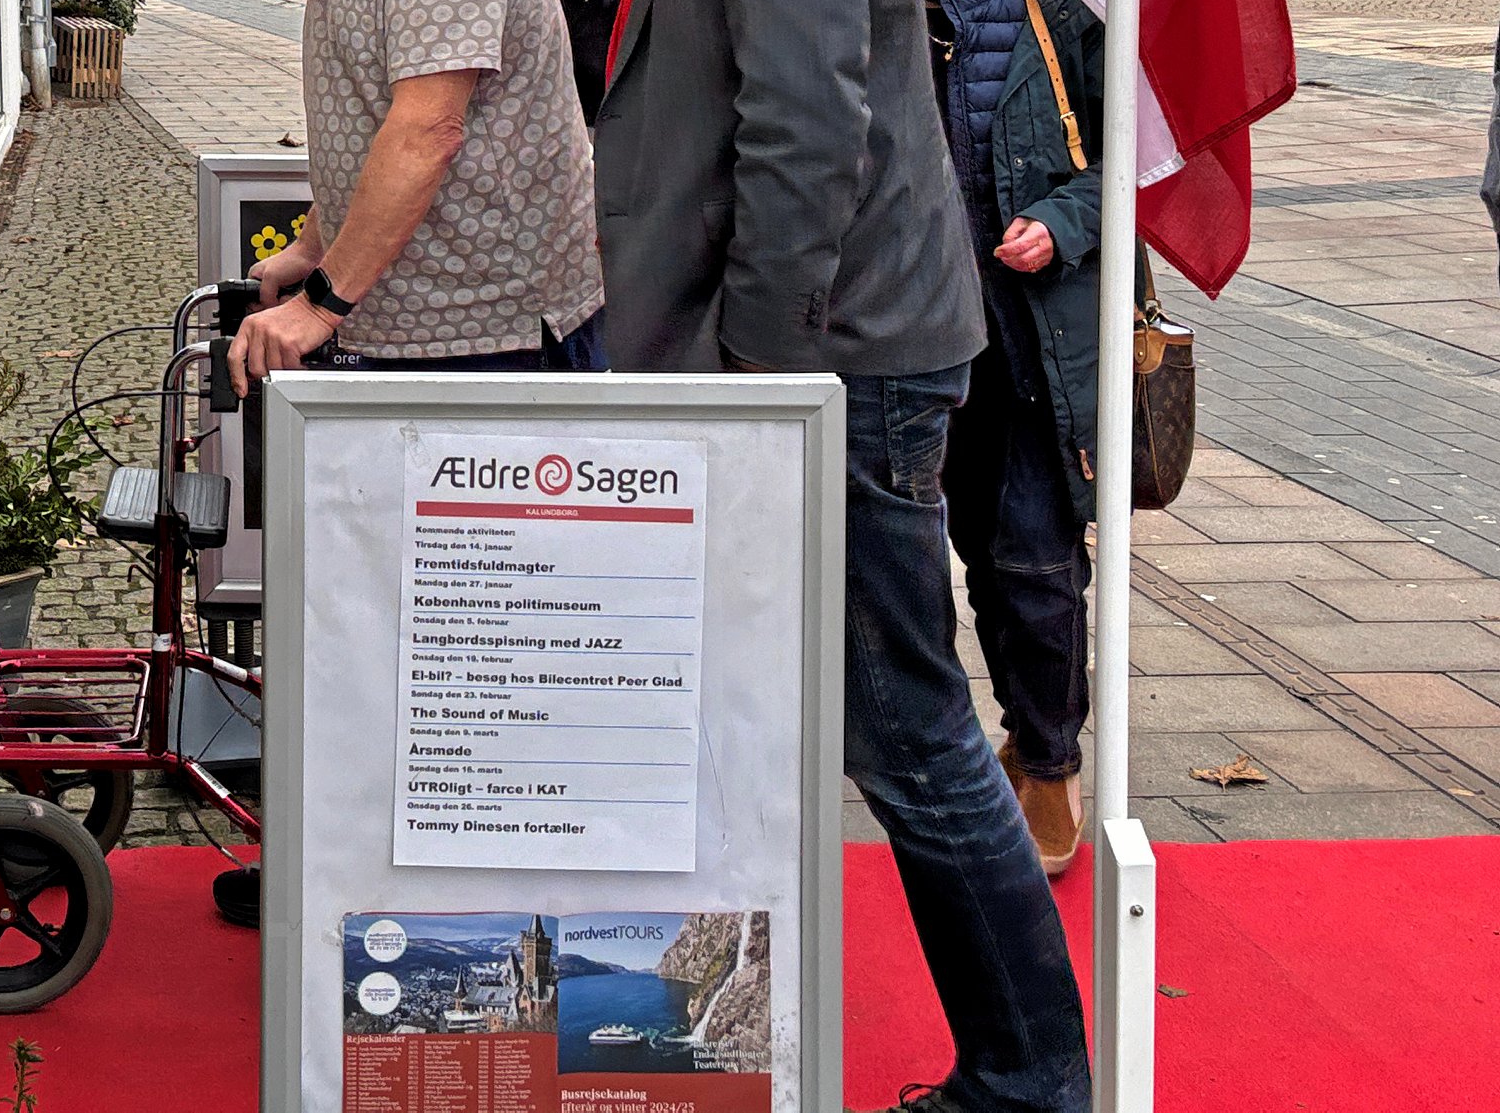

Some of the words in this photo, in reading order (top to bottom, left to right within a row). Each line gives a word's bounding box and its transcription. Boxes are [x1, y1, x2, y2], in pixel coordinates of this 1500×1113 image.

[430, 456, 530, 490] Ældre
[577, 460, 678, 504] Sagen
[525, 508, 579, 517] KALUNDBORG
[415, 526, 465, 536] Kommende
[415, 540, 448, 551] Tirsdag
[450, 542, 467, 550] den
[469, 542, 482, 551] 14.
[484, 542, 513, 553] januar
[414, 557, 556, 575] Fremtidsfuldmagter
[413, 578, 448, 589] Mandag
[450, 579, 467, 588] den
[469, 579, 483, 589] 27.
[484, 580, 513, 590] januar
[414, 595, 501, 610] Københavns
[504, 597, 601, 613] politimuseum
[412, 616, 446, 626] Onsdag
[448, 617, 465, 626] den
[467, 618, 476, 626] 5.
[477, 618, 509, 627] februar
[412, 633, 546, 650] Langbordsspisning
[550, 637, 581, 649] med
[584, 638, 623, 650] JAZZ
[412, 653, 445, 664] Onsdag
[447, 654, 463, 663] den
[481, 655, 514, 664] februar
[411, 670, 452, 682] El-bil?
[466, 671, 507, 685] besøg
[510, 673, 535, 684] hos
[539, 673, 614, 686] Bilecentret
[617, 675, 648, 687] Peer
[652, 676, 683, 688] Glad
[445, 691, 462, 700] den
[479, 691, 512, 701] februar
[411, 707, 437, 719] The
[441, 708, 486, 720] Sound
[489, 708, 504, 720] of
[508, 709, 550, 721] Music
[444, 728, 461, 736] den
[473, 729, 499, 738] marts
[409, 742, 472, 756] Årsmøde
[443, 765, 460, 774] den
[477, 766, 503, 775] marts
[408, 781, 473, 796] UTROligt
[487, 783, 524, 795] farce
[528, 784, 533, 795] i
[536, 784, 568, 796] KAT
[407, 801, 440, 812] Onsdag
[442, 802, 459, 811] den
[476, 803, 502, 812] marts
[407, 819, 459, 834] Tommy
[463, 820, 520, 833] Dinesen
[524, 821, 586, 835] fortæller
[564, 925, 664, 942] nordvestTOURS
[346, 1035, 406, 1045] Rejsekalender
[561, 1088, 647, 1102] Busrejsekatalog
[561, 1101, 597, 1113] Efterår
[599, 1104, 612, 1113] og
[614, 1102, 647, 1113] vinter
[649, 1101, 695, 1113] 2024/25
